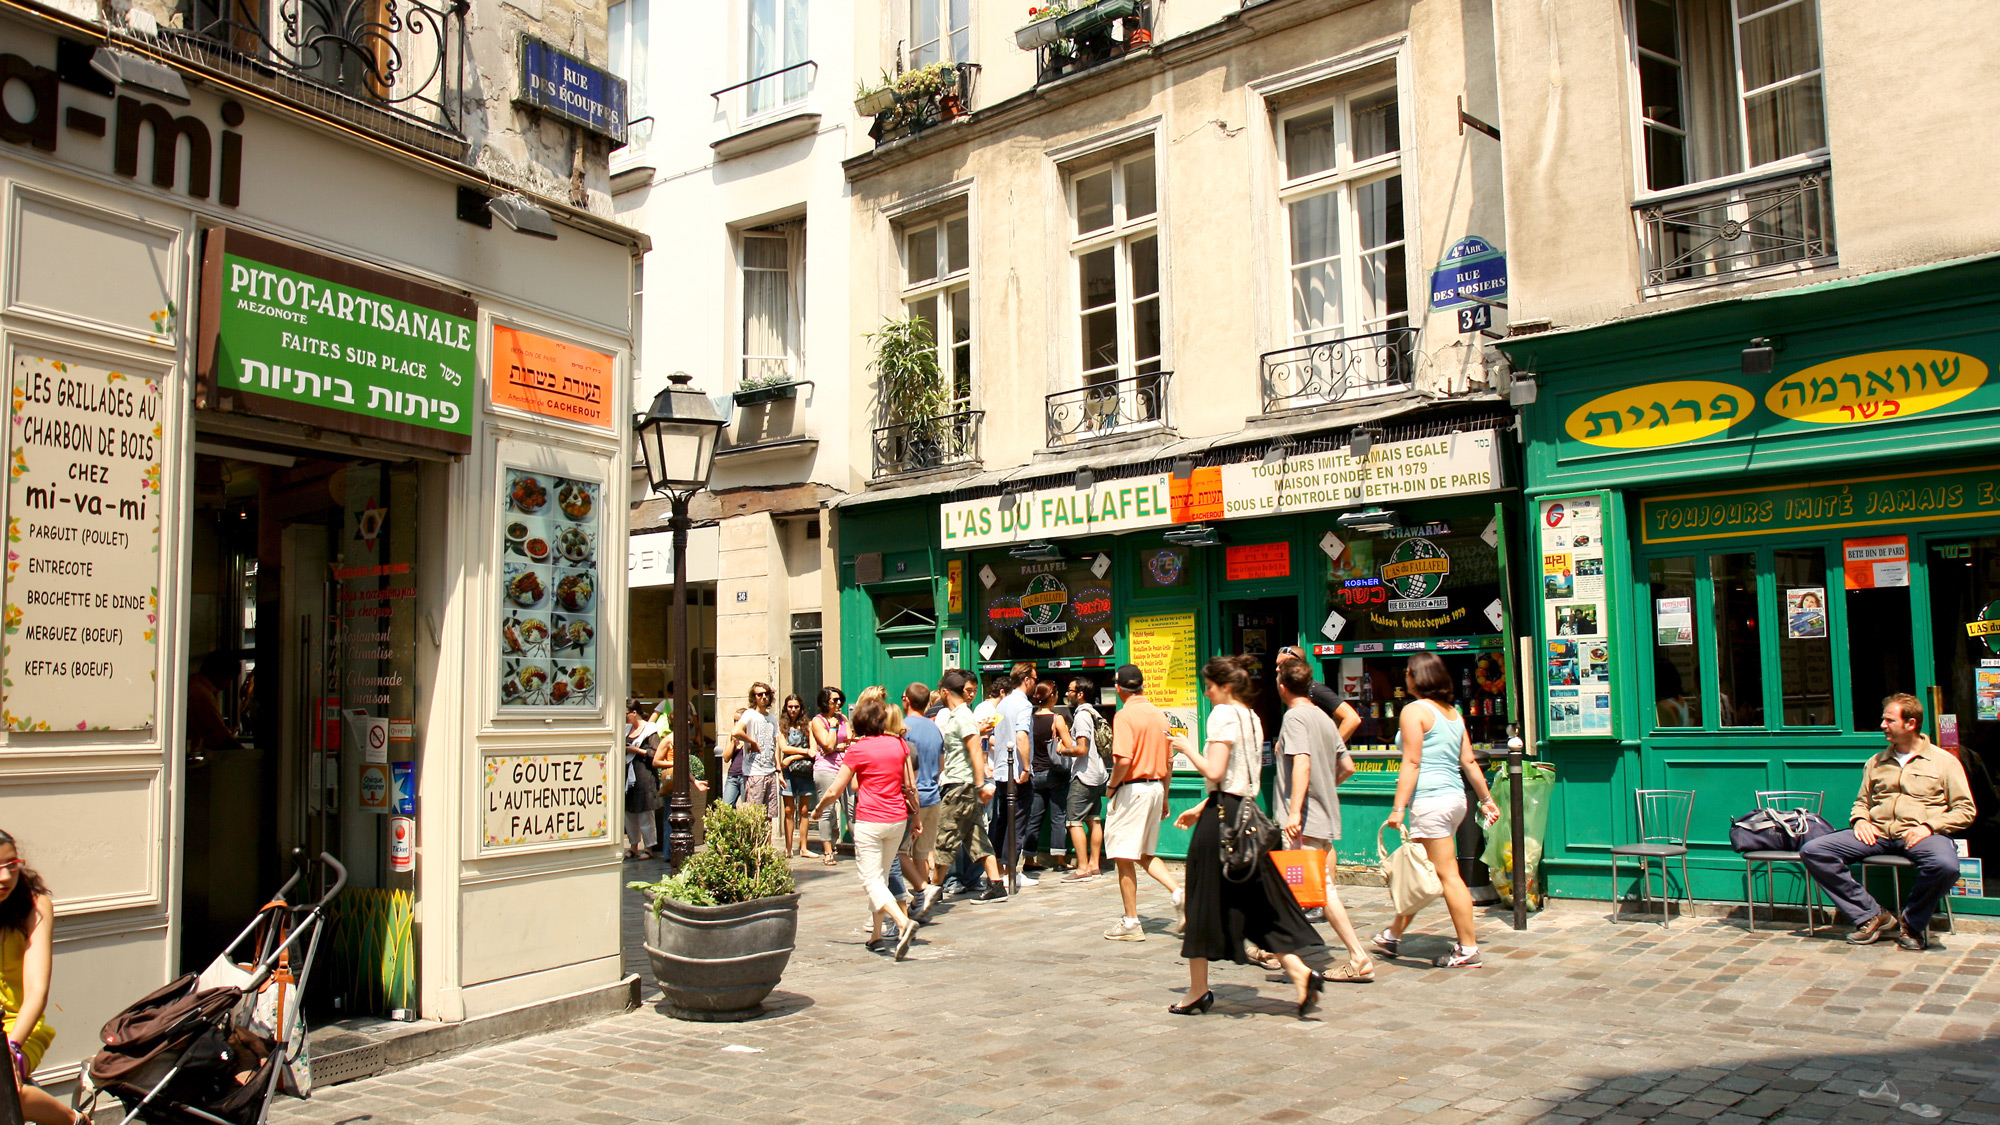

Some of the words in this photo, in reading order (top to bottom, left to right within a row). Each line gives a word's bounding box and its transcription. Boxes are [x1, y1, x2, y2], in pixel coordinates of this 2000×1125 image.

[564, 66, 588, 90] RUE
[531, 73, 556, 96] DES
[559, 83, 619, 124] ÉCOUFFES
[1456, 269, 1480, 283] RUE
[1433, 288, 1454, 302] DES
[1457, 277, 1506, 294] ROSIERS
[230, 263, 472, 351] PITOT-ARTISANALE
[237, 299, 308, 325] MEZONOTE
[1462, 306, 1486, 330] 34
[281, 332, 341, 359] FAITES
[346, 347, 377, 368] SUR
[381, 355, 428, 380] PLACE
[239, 358, 355, 405] ביתיות
[439, 362, 462, 387] כשר
[509, 364, 557, 389] כשרות
[1780, 354, 1961, 410] שווארמה
[25, 371, 51, 403] LES
[57, 380, 134, 418] GRILLADES
[139, 396, 157, 422] AU
[563, 376, 601, 401] תעודת
[367, 385, 461, 424] פיתות
[547, 399, 601, 419] CACHEROUT
[1584, 393, 1740, 439] פרגית
[1838, 398, 1901, 422] כשר
[23, 416, 93, 453] CHARBON
[98, 427, 116, 457] DE
[121, 434, 154, 462] BOIS
[1252, 457, 1315, 479] TOUJOURS
[1318, 453, 1351, 469] IMITE
[1355, 447, 1402, 466] JAMAIS
[1406, 441, 1449, 459] EGALE
[68, 463, 109, 484] CHEZ
[1274, 475, 1320, 492] MAISON
[1377, 465, 1394, 479] EN
[1398, 461, 1428, 477] 1979
[26, 481, 147, 521] mi-va-mi
[1226, 497, 1257, 513] SOUS
[1260, 494, 1274, 509] LE
[1278, 486, 1340, 507] CONTROLE
[1345, 485, 1361, 499] DU
[1366, 476, 1427, 497] BETH-DIN
[1430, 475, 1447, 489] DE
[1451, 471, 1491, 488] PARIS
[945, 506, 992, 540] L'AS
[1000, 501, 1031, 534] DU
[1041, 484, 1168, 529] FALLAFEL
[1191, 510, 1224, 521] CACHEROUT
[1656, 501, 1773, 530] TOUJOURS
[1784, 485, 1854, 520] IMITÉ
[1865, 484, 1963, 515] JAMAIS
[29, 523, 78, 542] PARGUIT
[81, 528, 129, 549] (POULET)
[1383, 523, 1450, 540] SCHAWARMA
[1149, 555, 1182, 570] OPEN
[1545, 554, 1566, 567] 파리
[1848, 550, 1864, 559] BETH
[1865, 548, 1877, 557] DIN
[1878, 548, 1887, 556] DE
[1888, 546, 1905, 556] PARIS
[1931, 543, 1972, 559] כשר
[29, 558, 93, 577] ENTRECOTE
[1021, 561, 1068, 575] FALLAFEL
[1409, 560, 1446, 573] FALLAFEL
[27, 591, 91, 608] BROCHETTE
[95, 593, 110, 608] DE
[111, 594, 145, 611] DINDE
[1337, 586, 1386, 605] כשר
[1389, 601, 1397, 609] RUE
[26, 625, 77, 642] MERGUEZ
[81, 626, 123, 646] (BOEUF)
[341, 625, 391, 645] Restaurant
[25, 661, 67, 677] KEFTAS
[71, 661, 114, 680] (BOEUF)
[346, 670, 403, 687] Citronnade
[513, 761, 583, 784] GOUTEZ
[490, 785, 603, 812] L'AUTHENTIQUE
[511, 811, 585, 838] FALAFEL
[392, 845, 408, 853] Ticket
